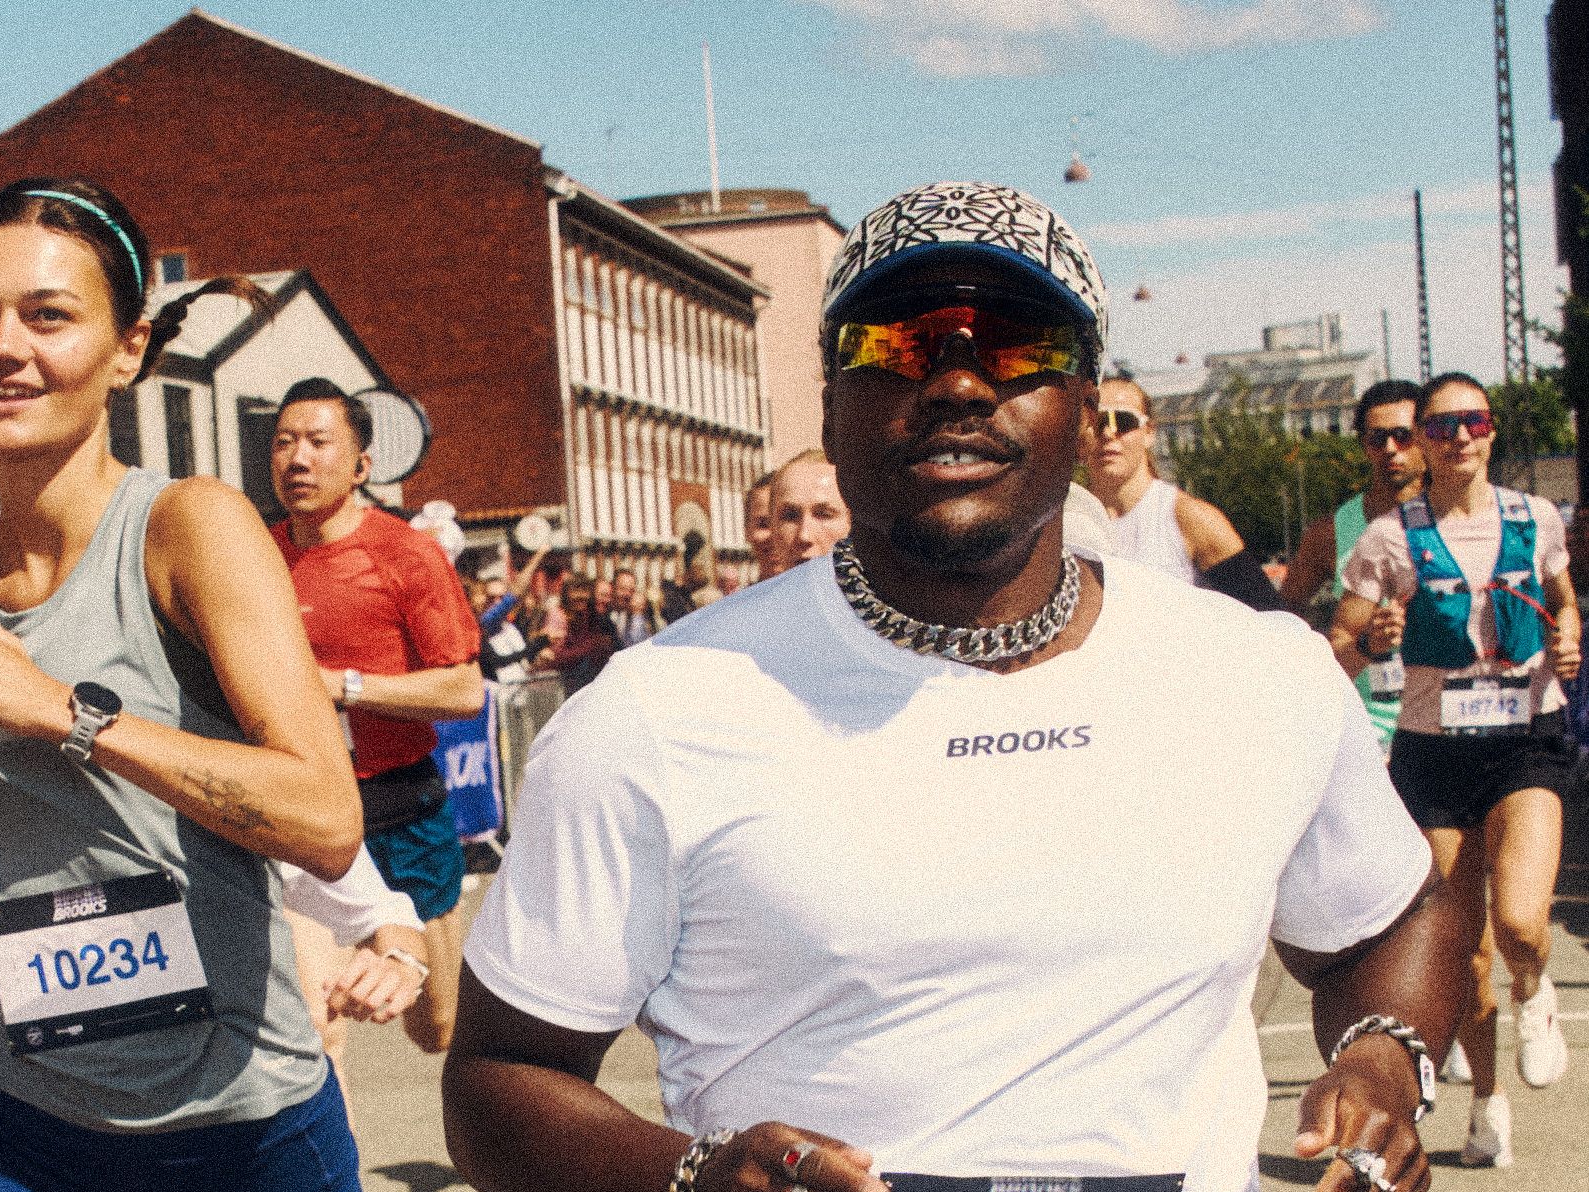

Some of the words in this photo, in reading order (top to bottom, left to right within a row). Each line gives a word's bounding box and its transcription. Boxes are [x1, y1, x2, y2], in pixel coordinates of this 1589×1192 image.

[946, 724, 1092, 758] BROOKS
[52, 897, 107, 922] BROOKS
[27, 930, 170, 994] 10234
